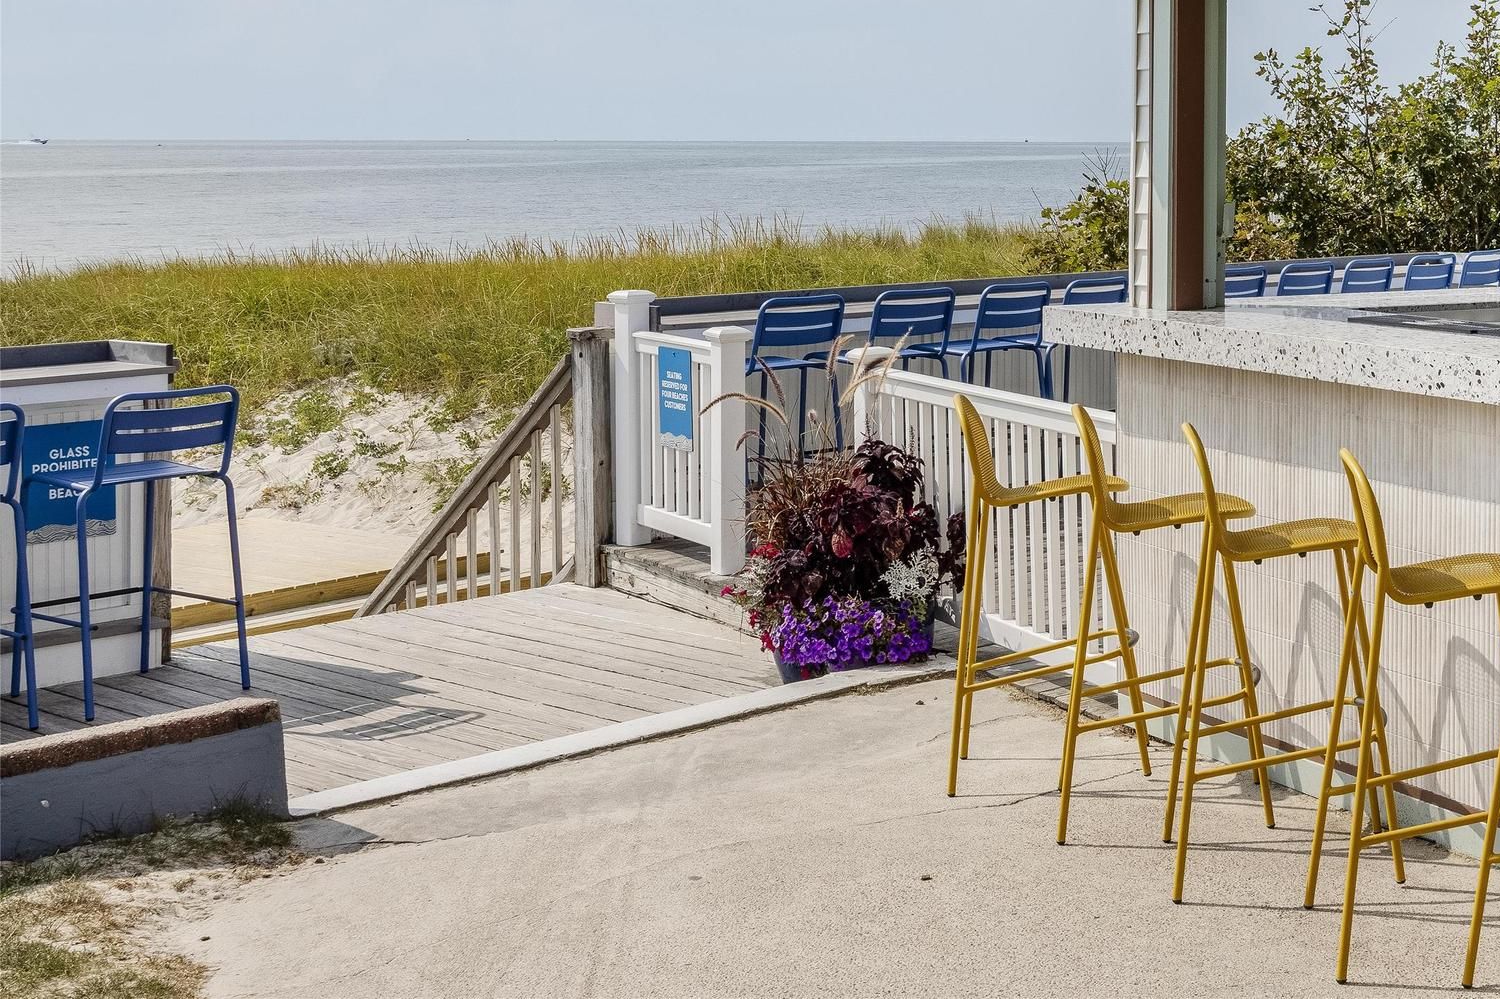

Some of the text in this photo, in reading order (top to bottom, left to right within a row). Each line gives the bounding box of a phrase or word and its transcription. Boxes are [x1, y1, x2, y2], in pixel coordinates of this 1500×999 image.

[680, 383, 688, 392] FOR
[661, 390, 672, 398] FOUR
[49, 445, 90, 460] GLASS
[32, 457, 106, 474] PROHIBITE
